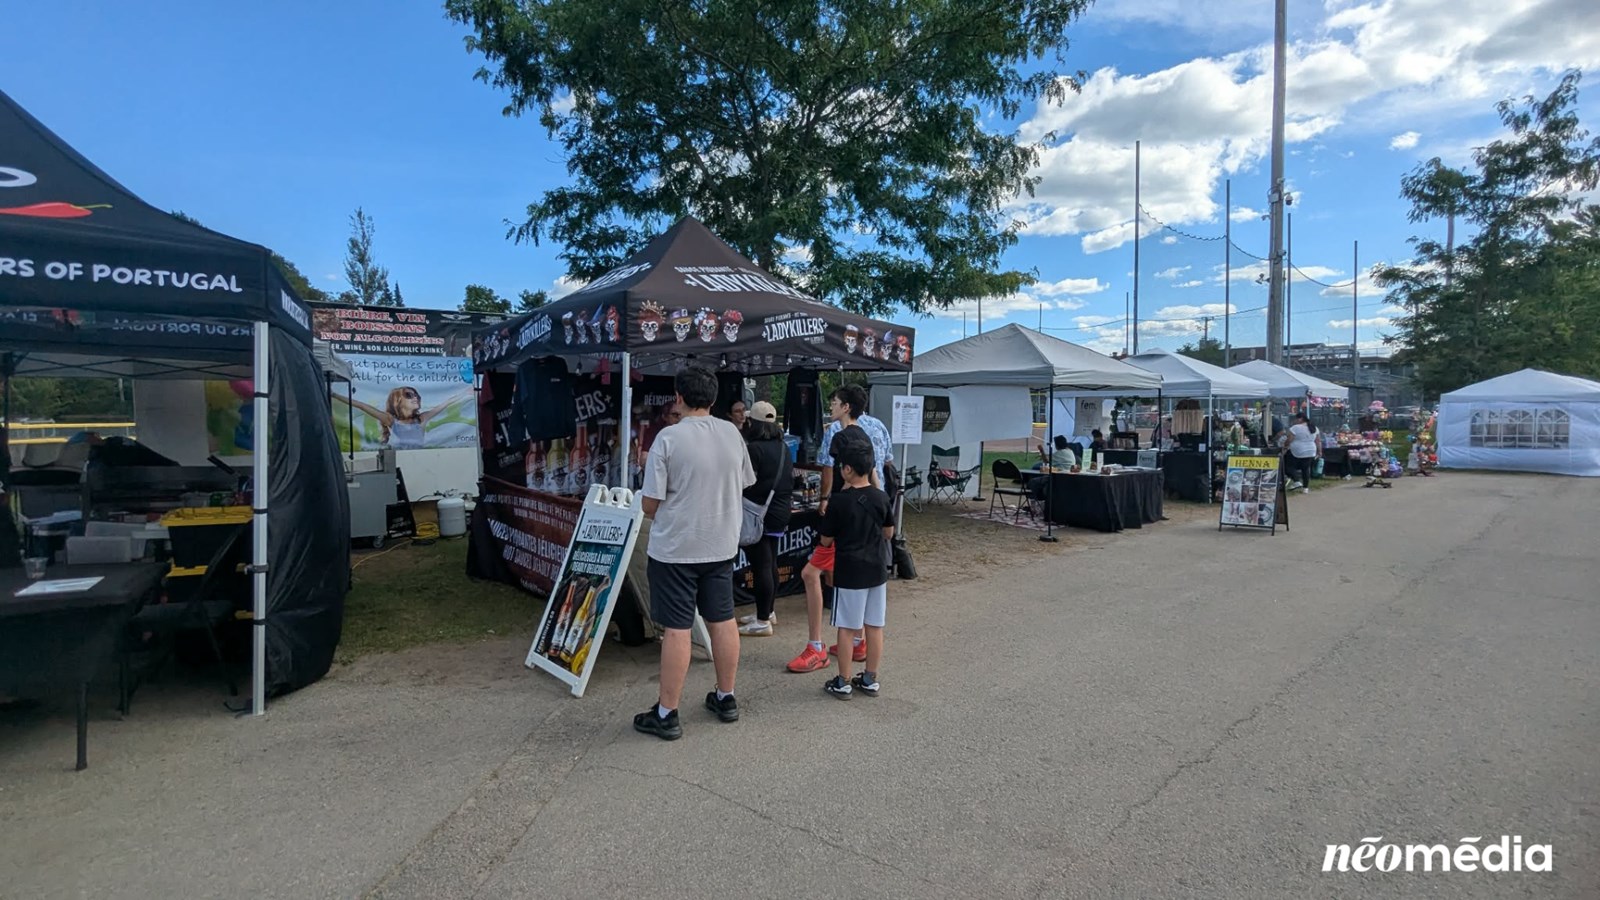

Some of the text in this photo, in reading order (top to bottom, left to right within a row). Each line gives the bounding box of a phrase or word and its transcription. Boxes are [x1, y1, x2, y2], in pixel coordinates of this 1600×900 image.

[45, 261, 83, 280] OF
[93, 264, 243, 293] PORTUGAL
[396, 312, 430, 325] VIN,
[341, 320, 426, 333] BOISSONS
[765, 317, 824, 342] LADYKILLERS
[320, 331, 444, 345] NON ALCOOLISÉES
[344, 344, 365, 352] WINE,
[366, 344, 381, 352] NON
[383, 345, 420, 353] ALCOHOLIC
[372, 360, 402, 371] pour
[405, 360, 422, 369] les
[350, 371, 371, 381] All
[375, 371, 393, 384] for
[396, 372, 415, 382] the
[1235, 459, 1270, 468] HENNA
[583, 524, 621, 541] LADYKILLERS
